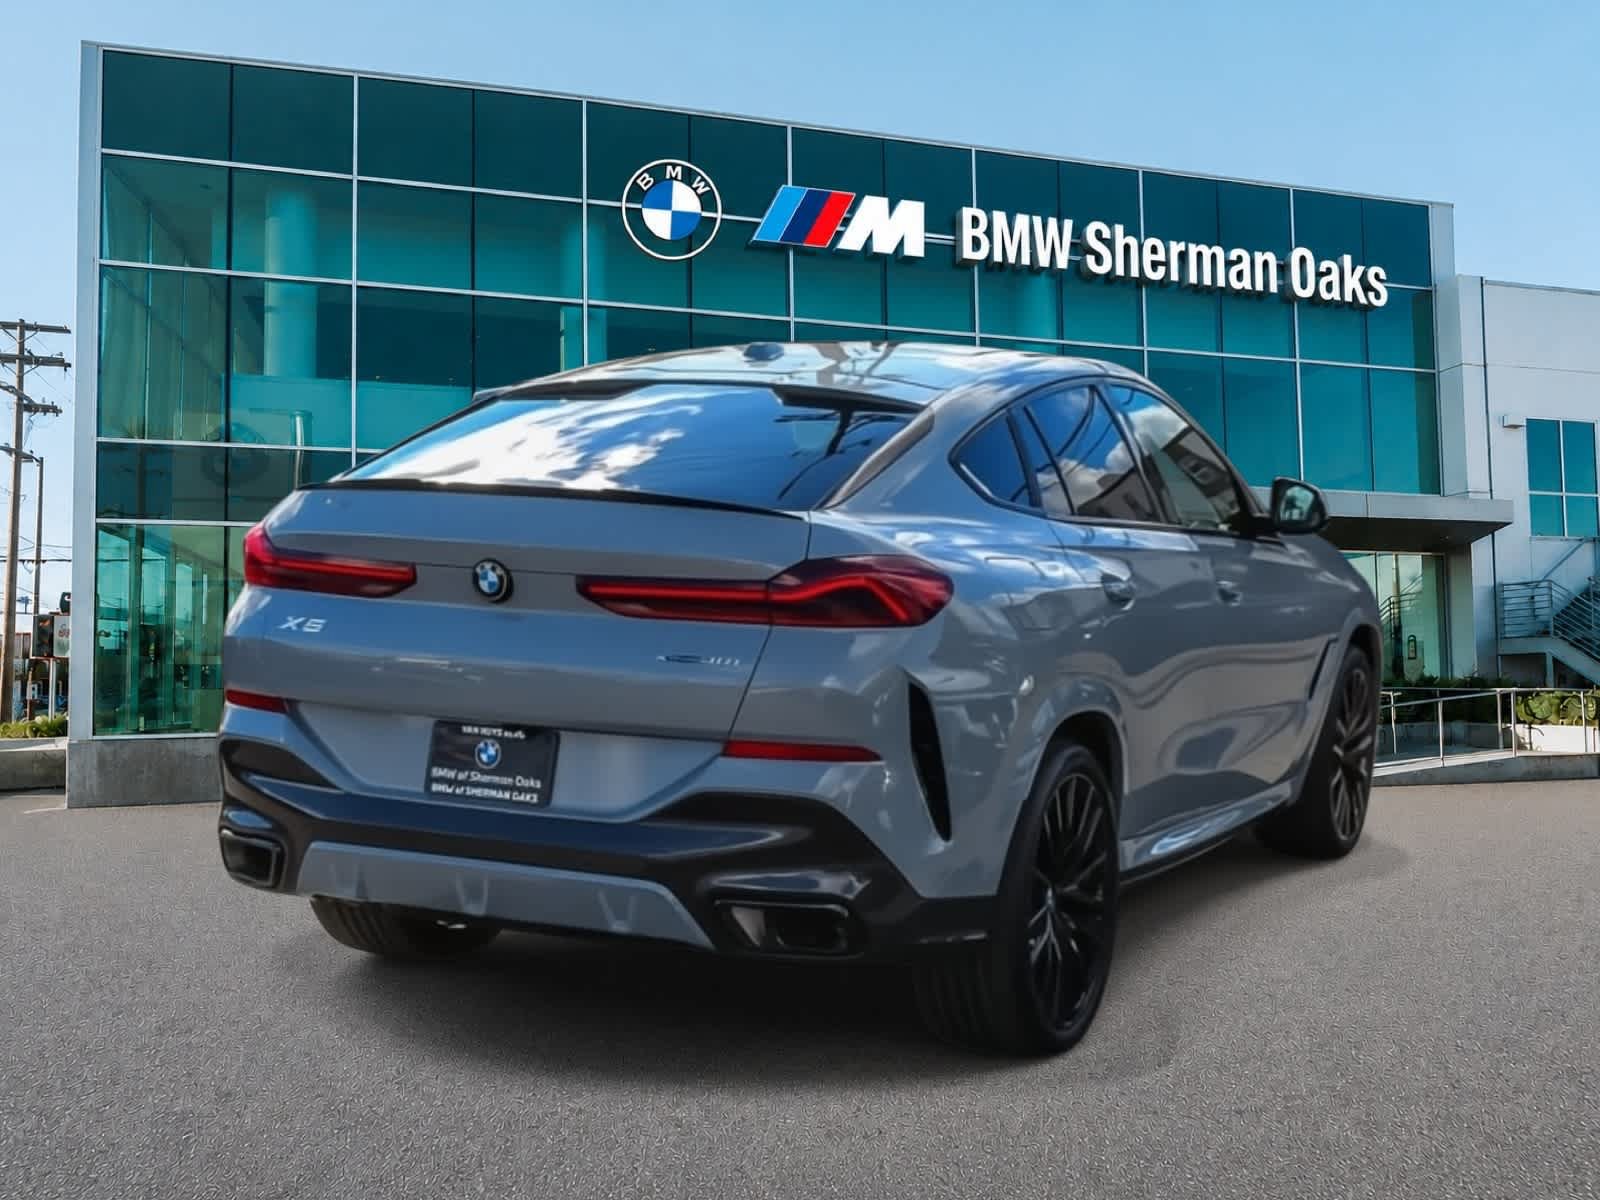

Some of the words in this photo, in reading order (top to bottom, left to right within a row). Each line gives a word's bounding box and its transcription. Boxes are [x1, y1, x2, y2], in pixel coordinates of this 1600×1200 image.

[635, 164, 712, 196] BMW
[834, 194, 925, 258] M
[959, 206, 1073, 270] BMW
[1083, 219, 1279, 295] Sherman
[1289, 246, 1389, 308] Oaks
[431, 767, 456, 780] BMW
[469, 771, 514, 786] Sherman
[515, 776, 542, 789] Oaks
